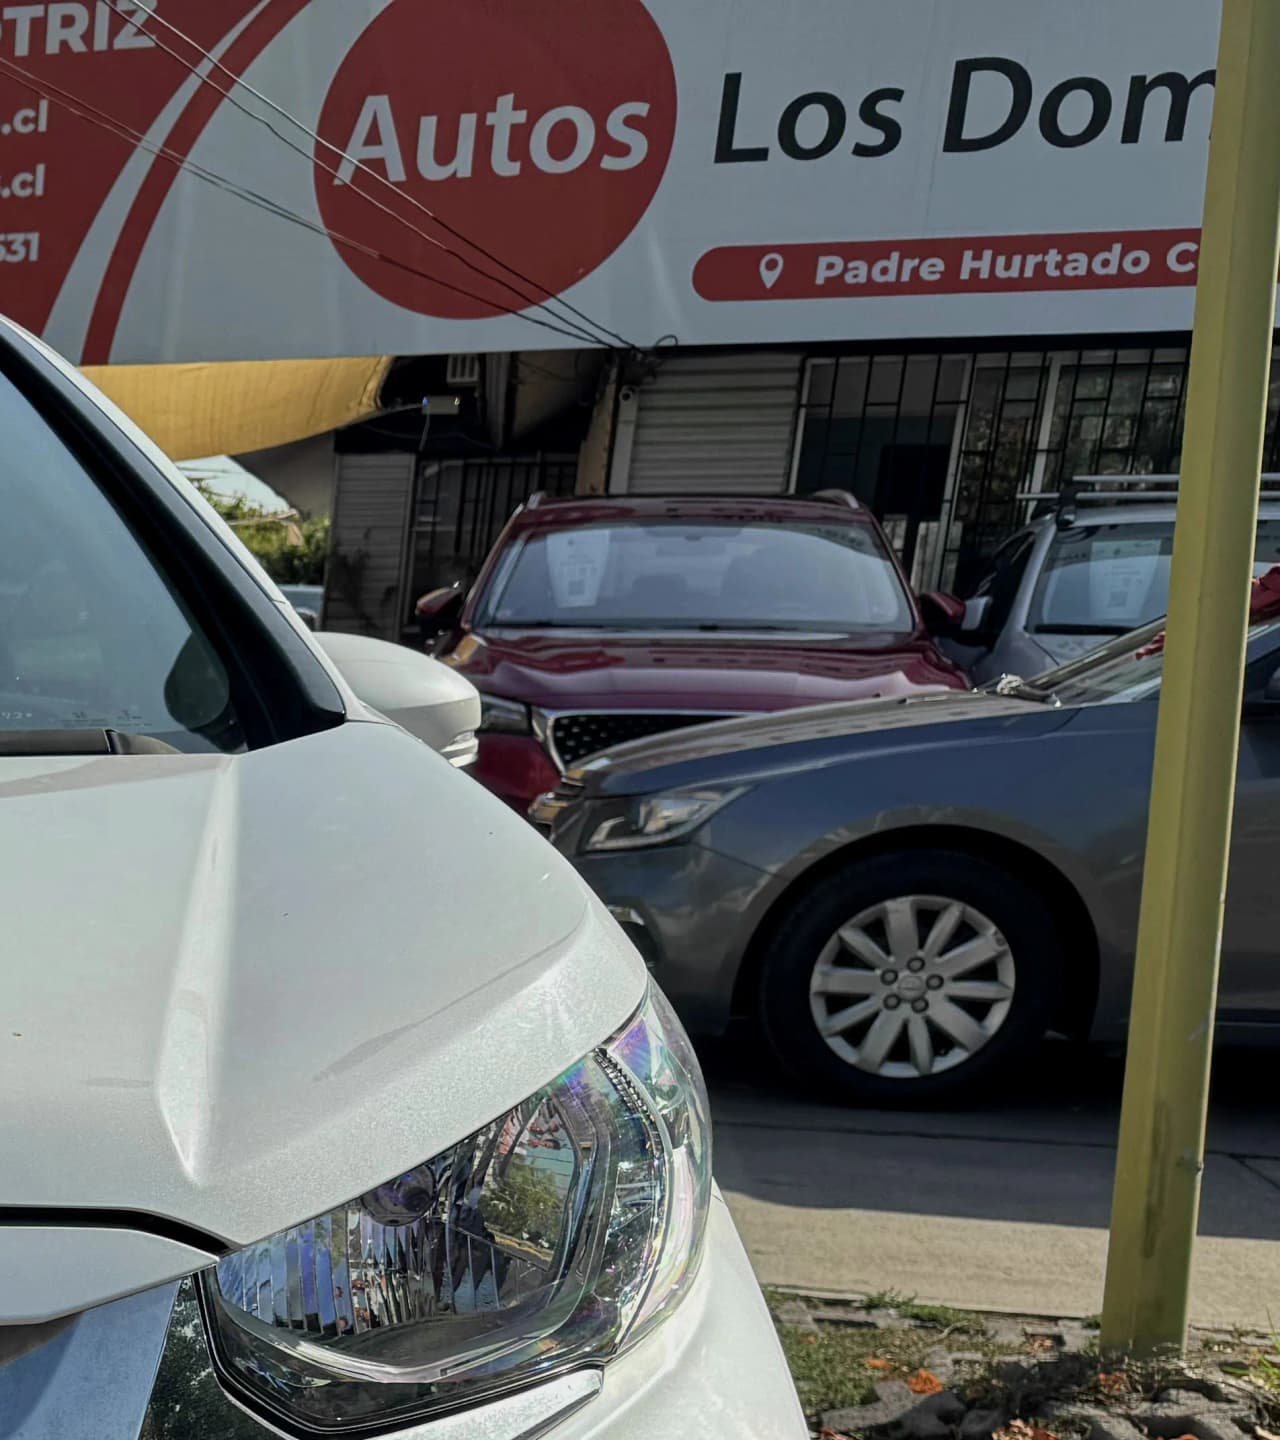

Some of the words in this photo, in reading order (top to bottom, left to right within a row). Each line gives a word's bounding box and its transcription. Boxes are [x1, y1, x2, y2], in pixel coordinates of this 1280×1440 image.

[333, 93, 650, 186] Autos
[715, 72, 905, 164] Los
[814, 252, 945, 286] Padre
[959, 242, 1151, 280] Hurtado
